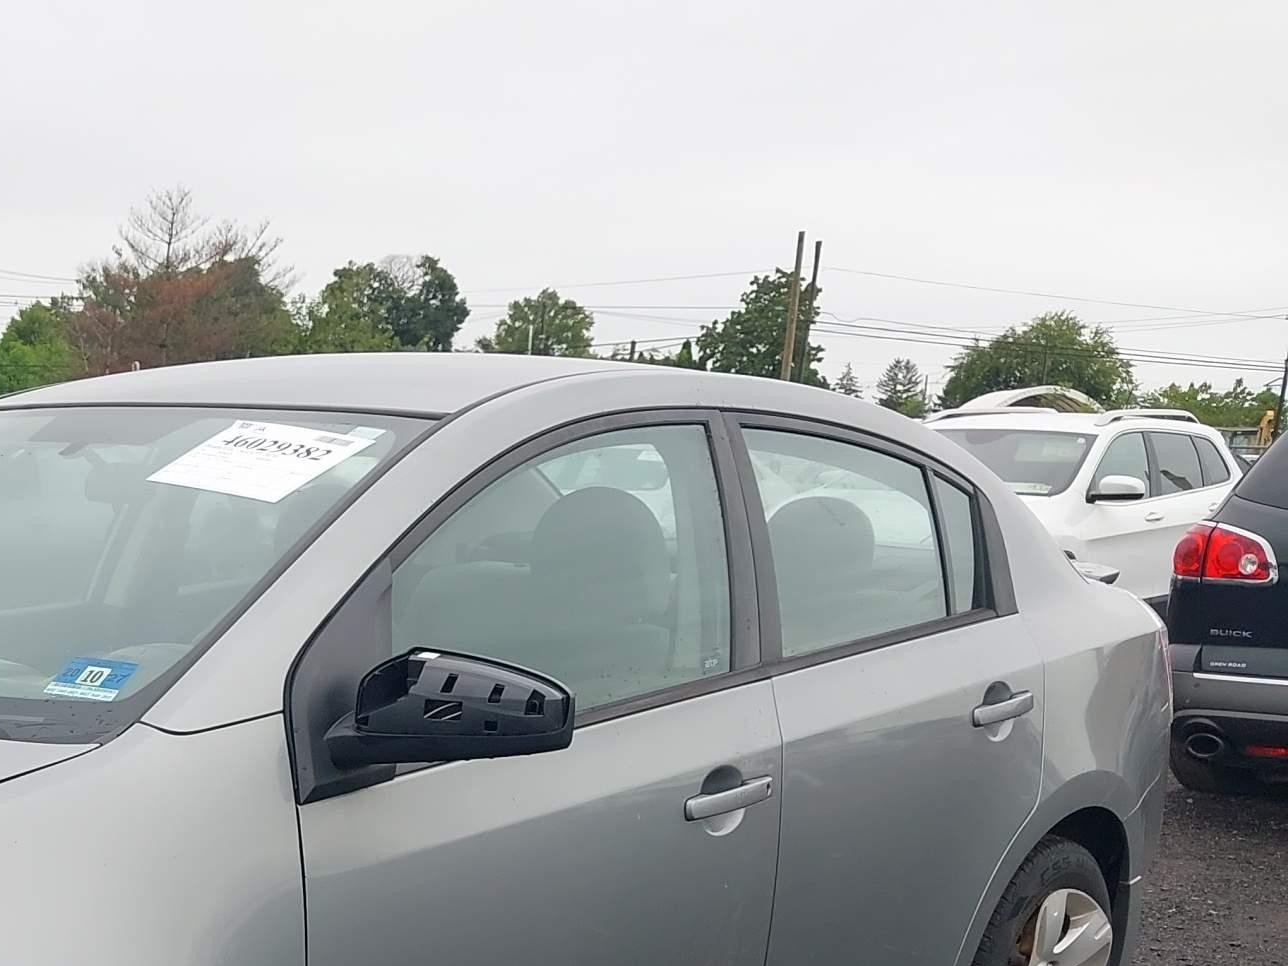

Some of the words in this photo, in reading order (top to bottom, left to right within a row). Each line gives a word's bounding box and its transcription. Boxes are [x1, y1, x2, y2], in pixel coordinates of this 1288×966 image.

[223, 434, 333, 462] 46029382
[1210, 628, 1253, 638] BUICK
[80, 669, 105, 684] 10
